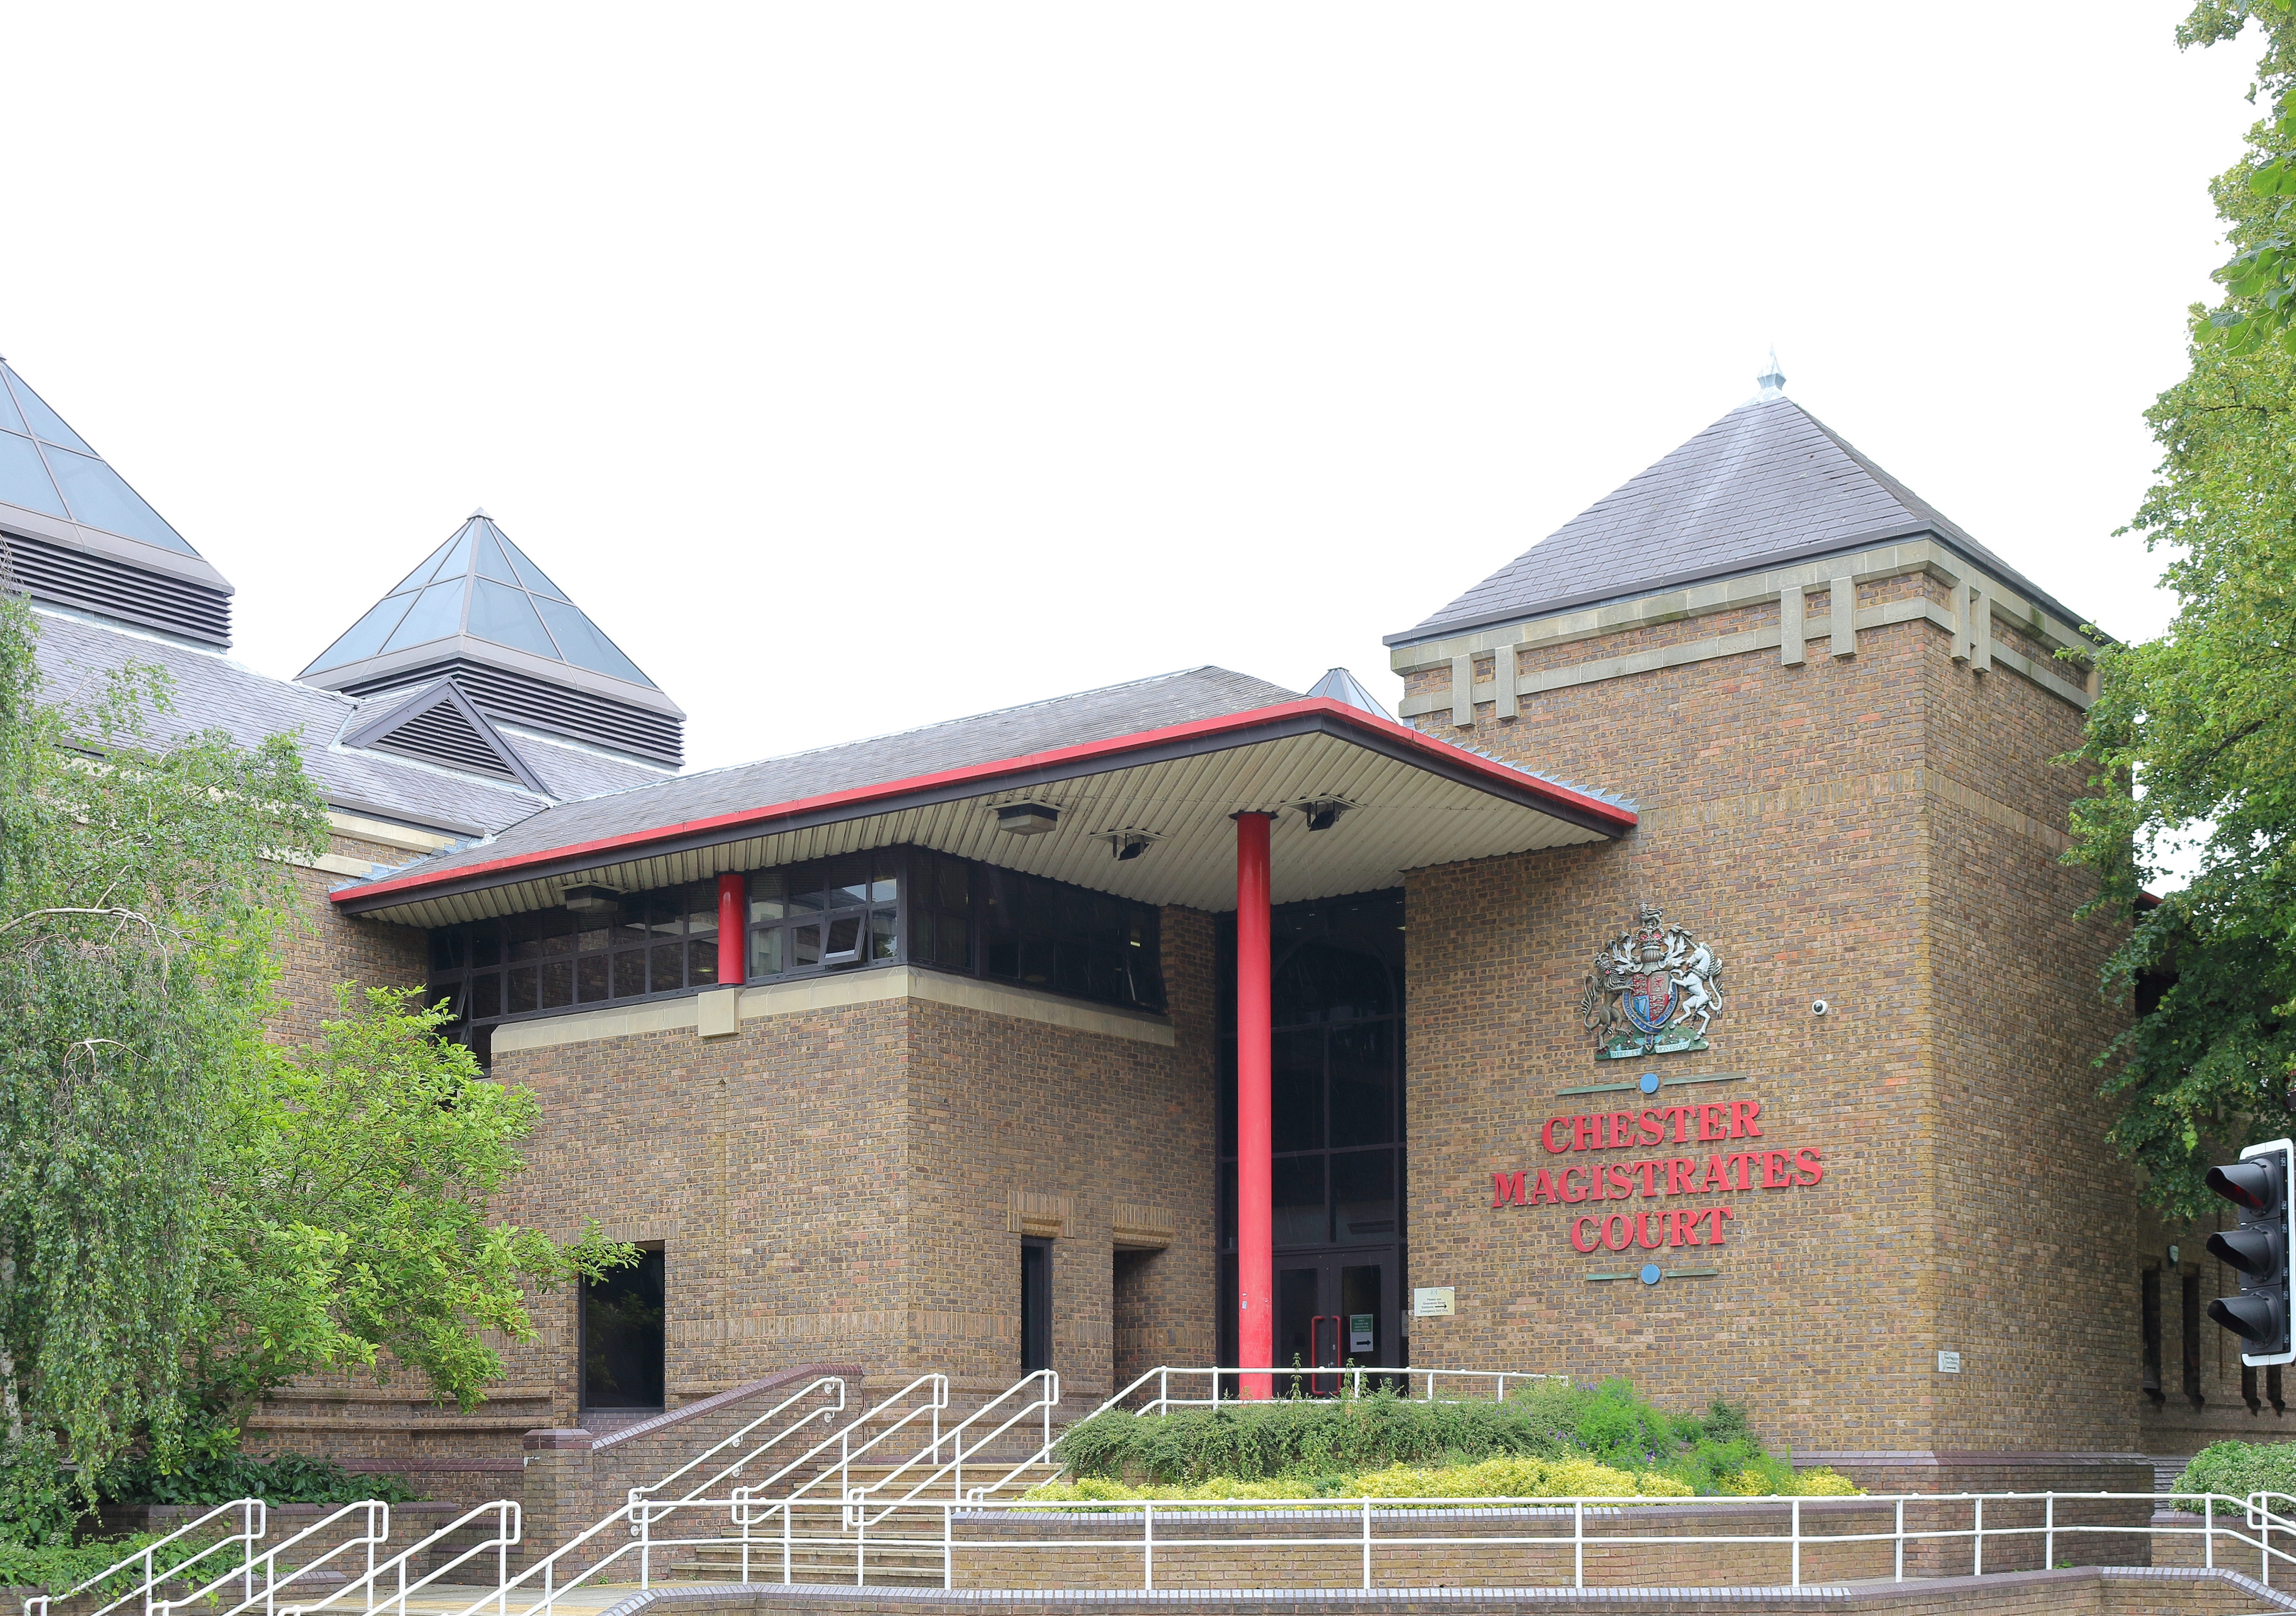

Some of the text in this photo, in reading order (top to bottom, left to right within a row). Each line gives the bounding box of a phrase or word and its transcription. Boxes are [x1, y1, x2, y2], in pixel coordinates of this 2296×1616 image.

[1541, 1100, 1763, 1153] CHESTER
[1492, 1147, 1823, 1208] MAGISTRATES
[1571, 1206, 1732, 1252] COURT
